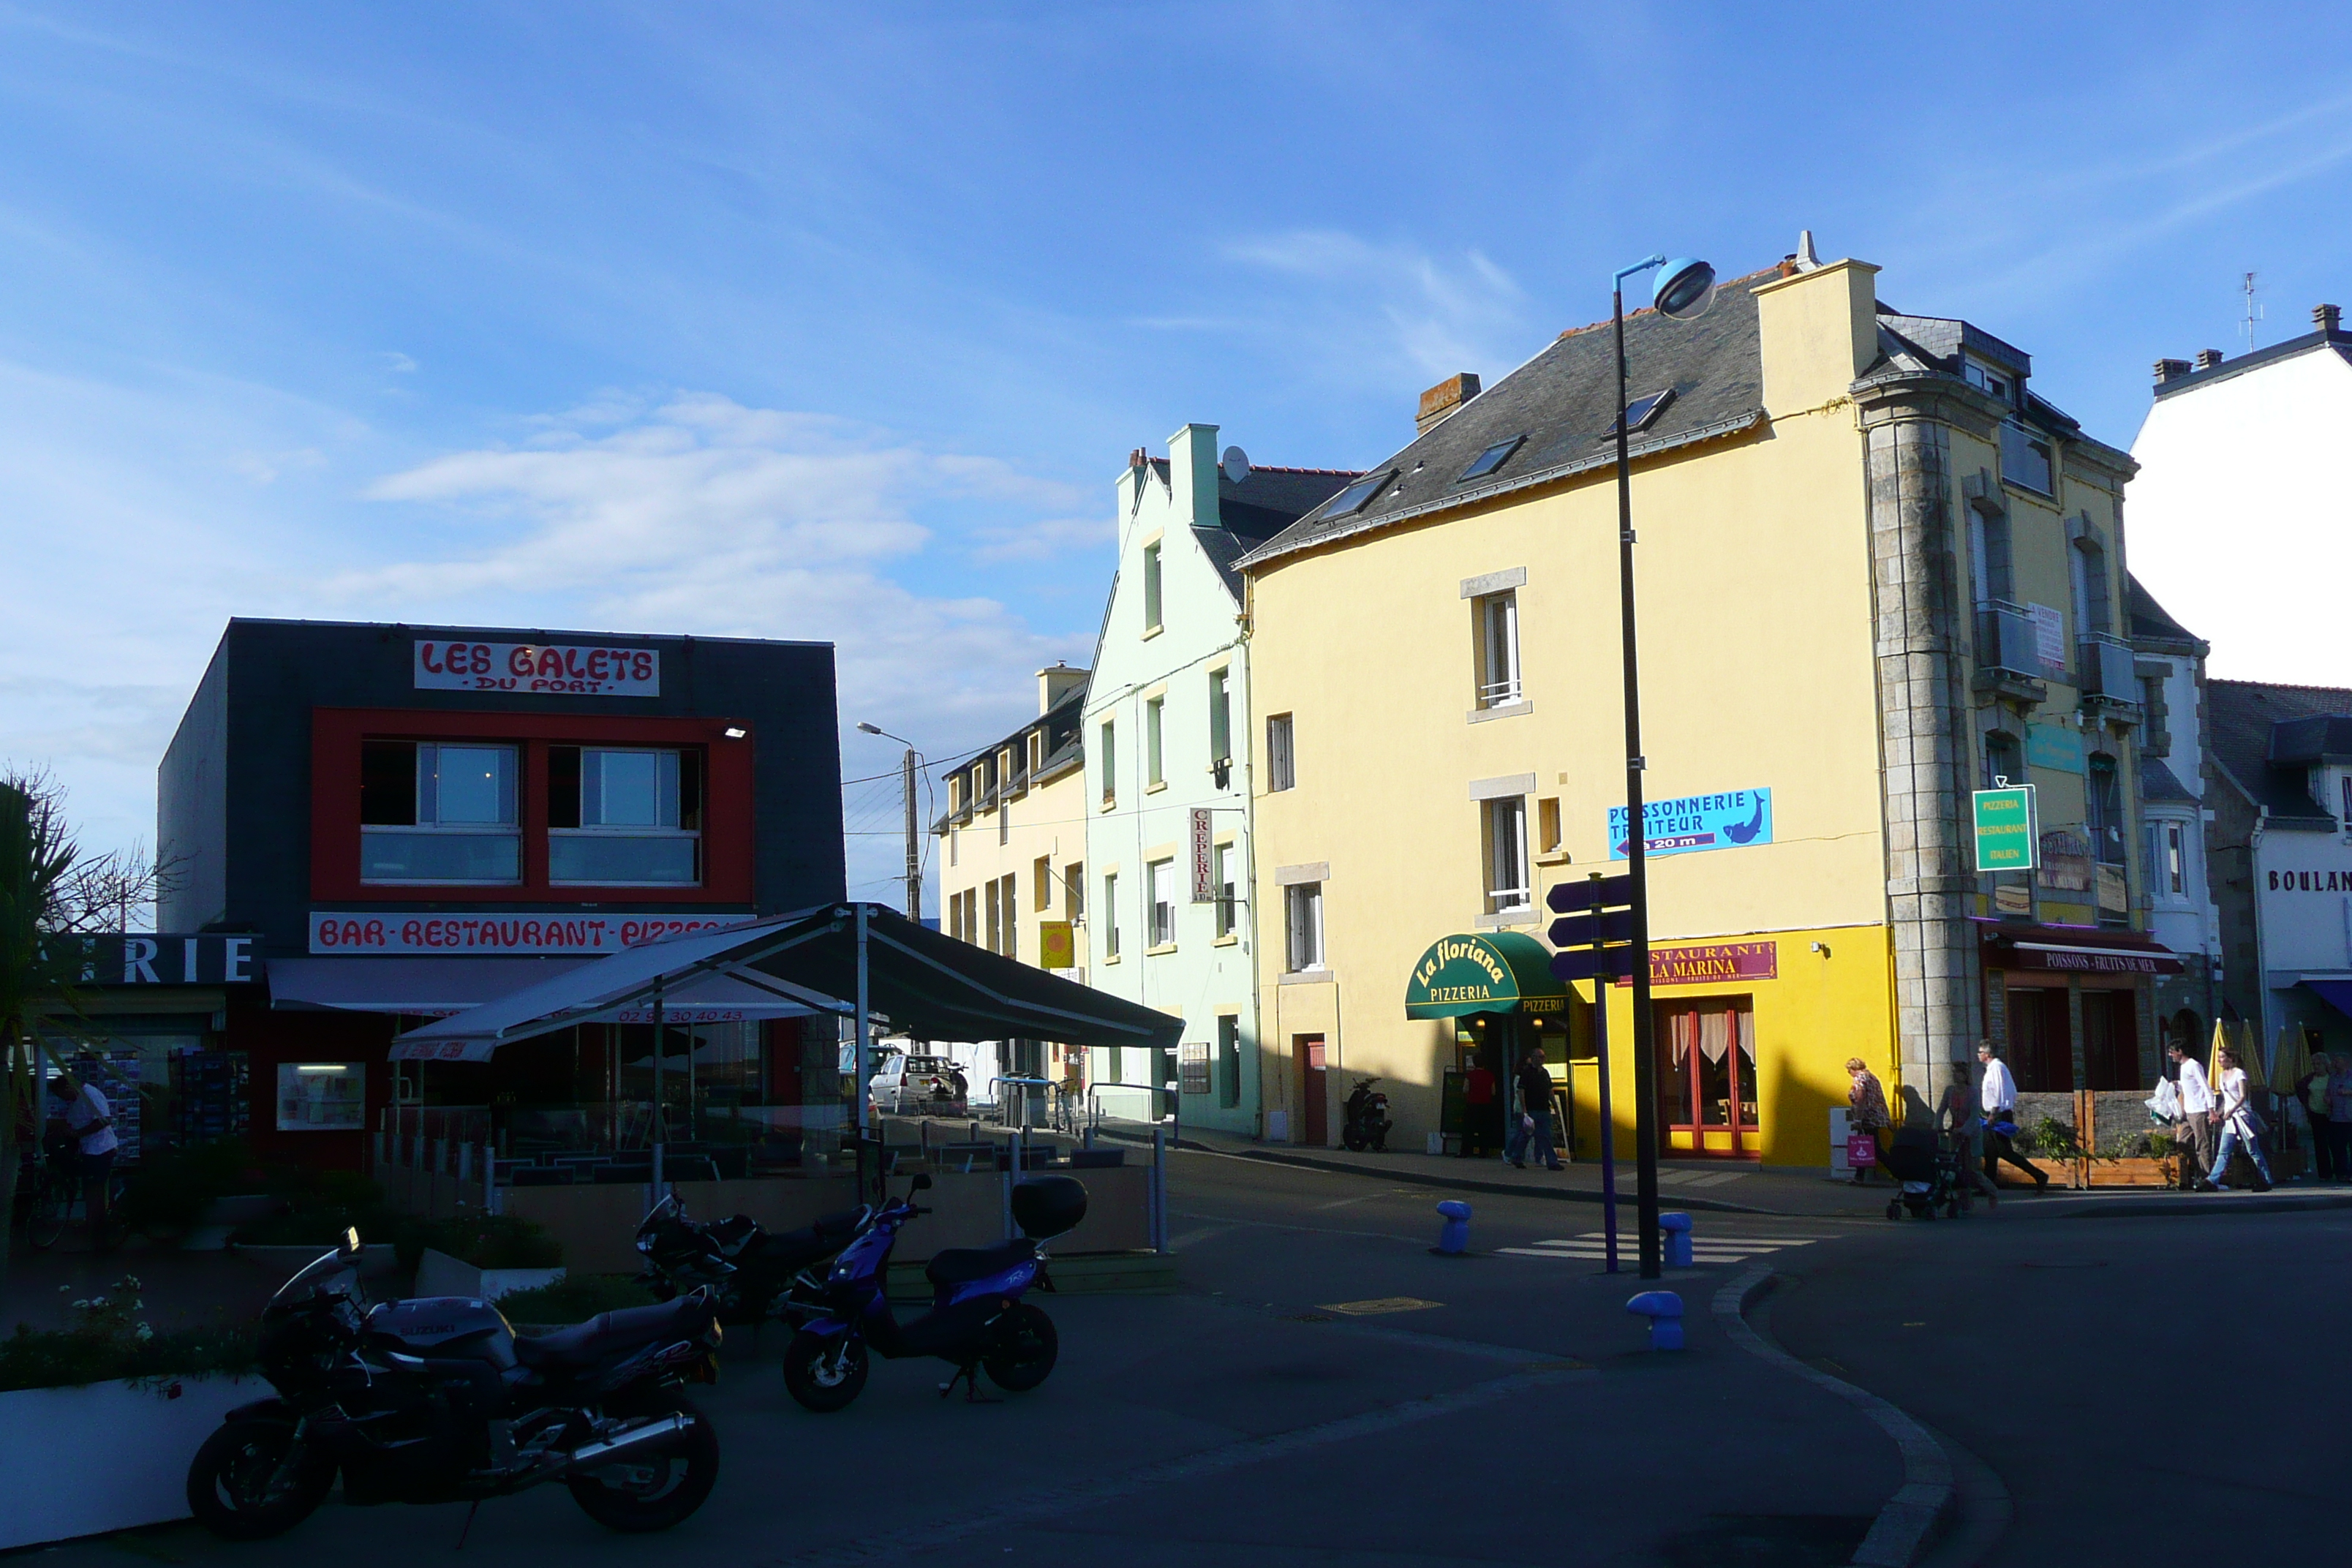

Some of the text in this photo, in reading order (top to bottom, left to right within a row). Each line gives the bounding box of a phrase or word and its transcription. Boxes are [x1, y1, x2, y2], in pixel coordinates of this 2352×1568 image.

[422, 643, 652, 681] LES GALETS
[475, 677, 601, 693] DU PORT
[1610, 792, 1745, 823] POSSONNERIE
[1983, 799, 2019, 810] PIZZERIA
[1611, 815, 1703, 839] TRITEUR
[1978, 824, 2027, 835] RESTAURANT
[1654, 839, 1676, 848] 20
[1680, 837, 1696, 846] m
[1991, 849, 2019, 859] ITALIEN
[2269, 870, 2352, 892] BOULAN
[1199, 893, 1205, 901] 10
[320, 919, 385, 946] BAR
[403, 920, 605, 946] RESTAURANT
[1416, 938, 1505, 988] La floriana
[1650, 959, 1735, 979] LA MARINA
[2046, 952, 2157, 973] POISSONS FRUITS DE MER
[1431, 984, 1490, 1002] PIZZERIA
[1523, 998, 1565, 1013] PIZZERIA
[619, 1011, 640, 1022] 02
[670, 1011, 691, 1022] 30
[696, 1011, 717, 1021] 40
[722, 1010, 742, 1020] 43
[400, 1324, 455, 1336] SUZUKI
